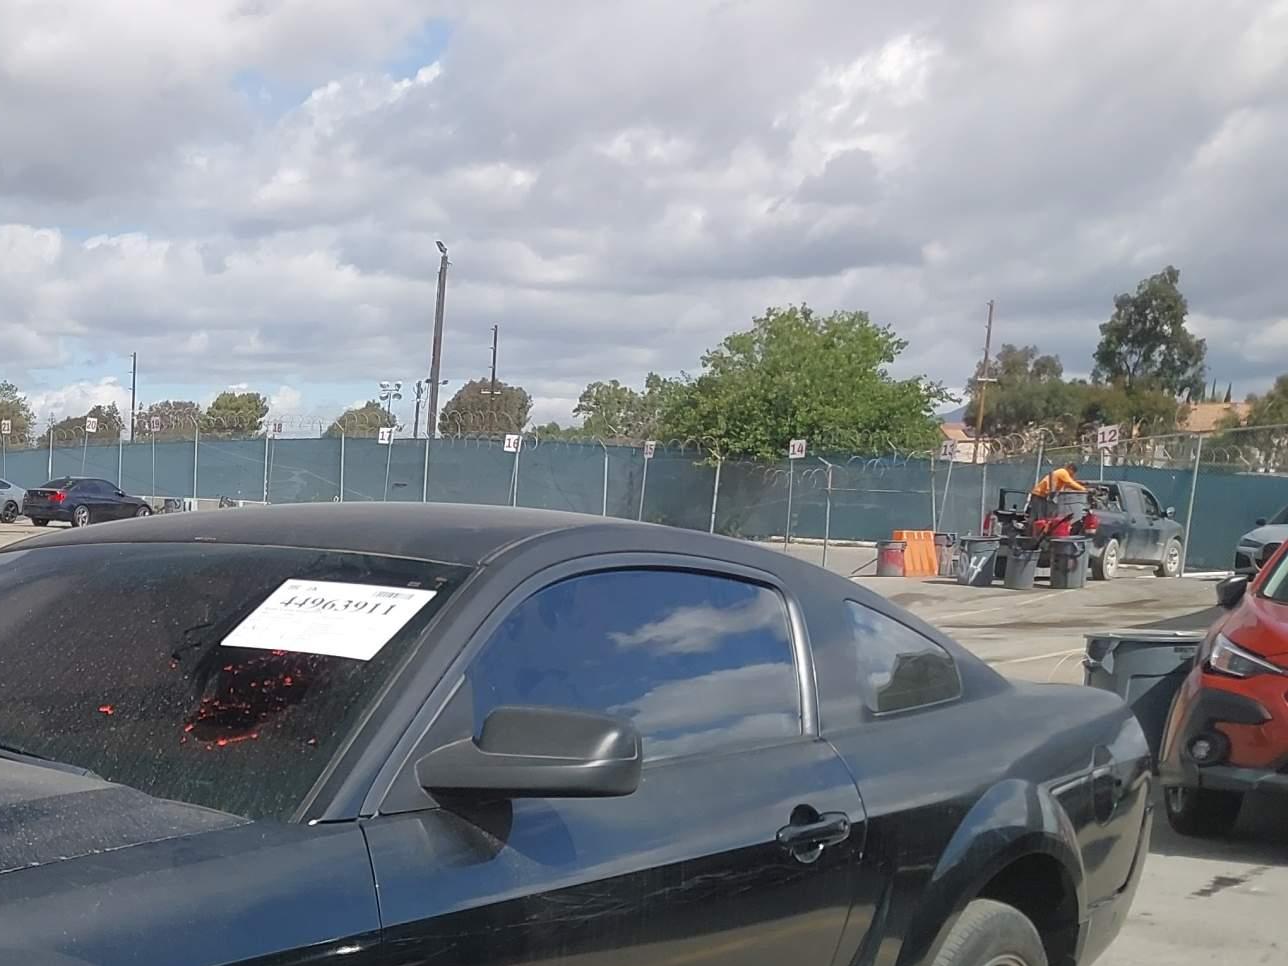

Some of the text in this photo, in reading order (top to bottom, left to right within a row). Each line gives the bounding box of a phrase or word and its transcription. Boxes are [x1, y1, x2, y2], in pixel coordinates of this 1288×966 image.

[2, 423, 10, 432] 21
[87, 421, 96, 430] 20
[1099, 430, 1117, 444] 12
[506, 439, 519, 449] 16
[791, 445, 804, 455] 14
[280, 596, 396, 615] 44963911
